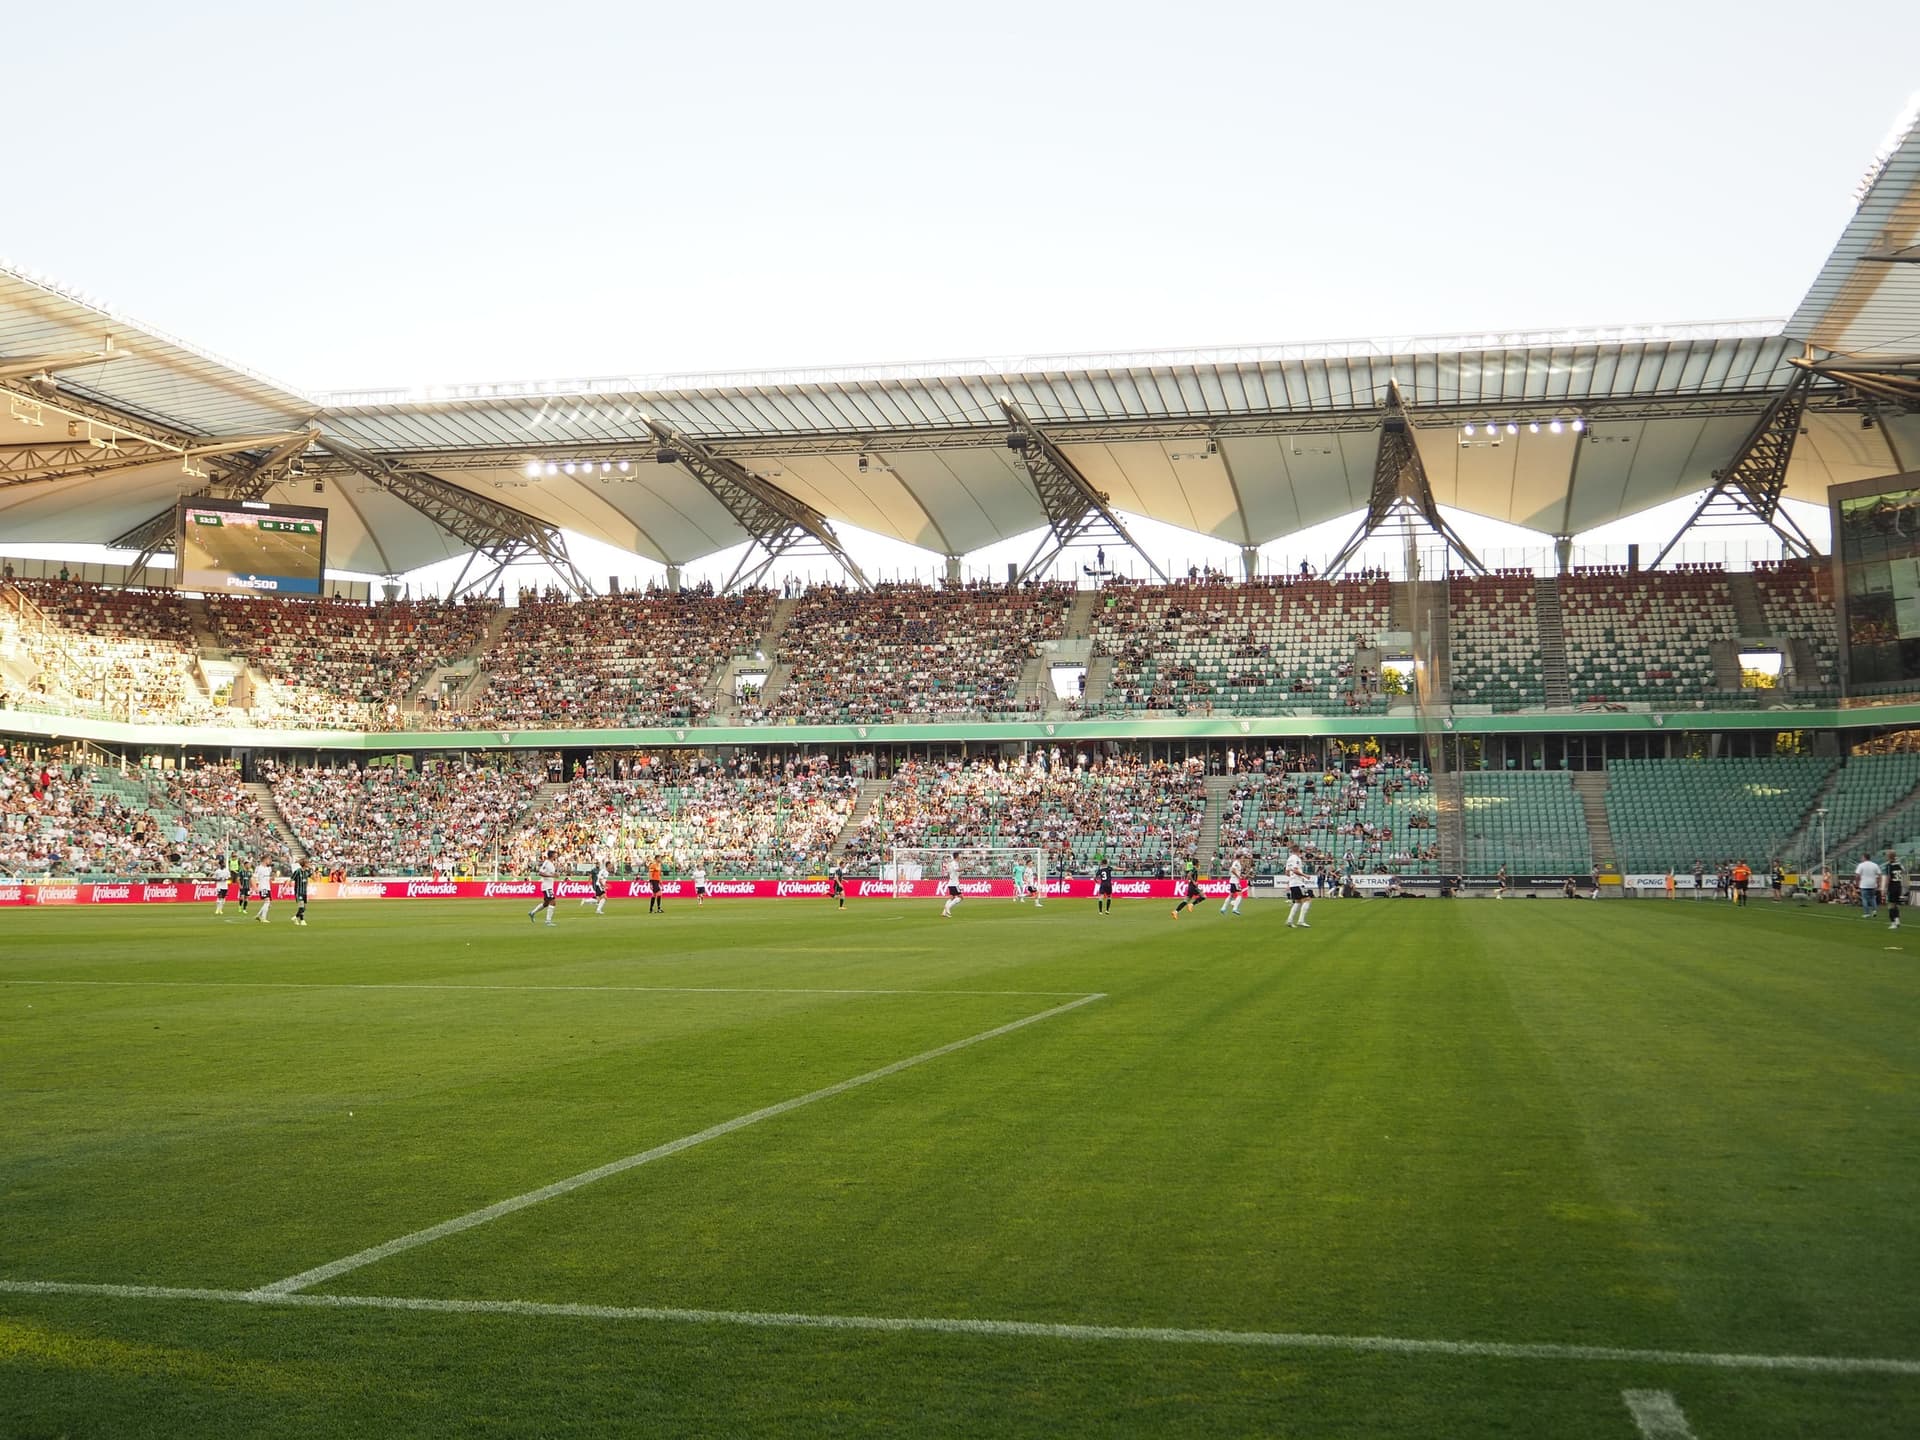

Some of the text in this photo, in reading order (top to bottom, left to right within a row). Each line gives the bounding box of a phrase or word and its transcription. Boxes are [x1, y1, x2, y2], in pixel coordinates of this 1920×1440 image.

[227, 577, 278, 590] Plus500
[1101, 871, 1107, 880] 3
[407, 882, 457, 897] Królewskie
[484, 882, 536, 896] Królewskie
[777, 881, 830, 896] Królewskie
